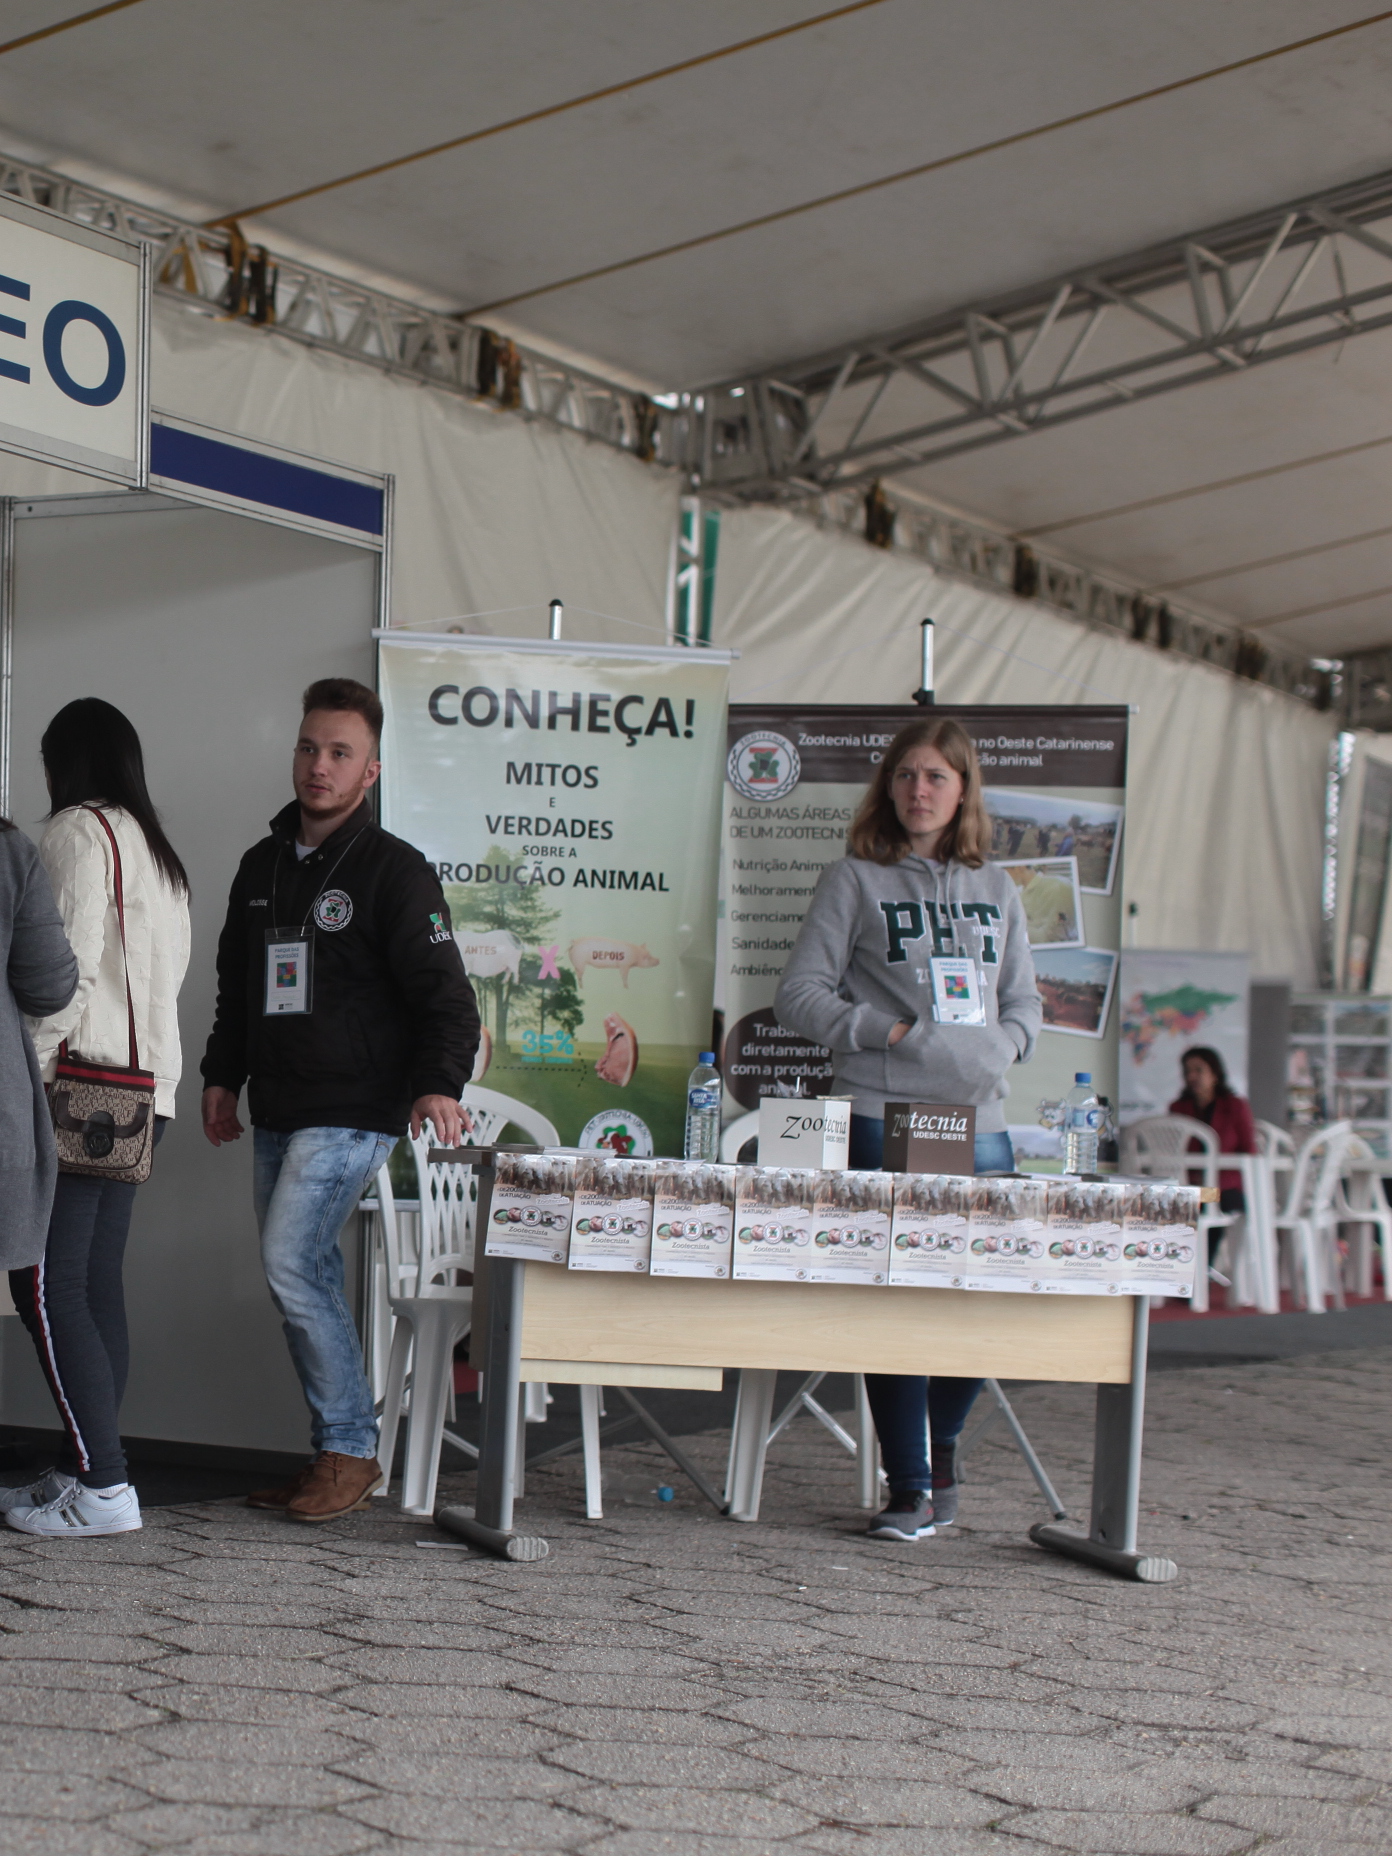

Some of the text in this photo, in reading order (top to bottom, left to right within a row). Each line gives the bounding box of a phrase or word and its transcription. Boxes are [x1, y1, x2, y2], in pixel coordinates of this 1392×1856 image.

[428, 684, 696, 747] CONHEÇA!
[798, 733, 860, 747] Zootecnia
[978, 738, 996, 748] no
[997, 736, 1034, 749] Oeste
[1036, 736, 1115, 750] Catarinense
[999, 753, 1044, 767] animal
[505, 761, 599, 789] MITOS
[549, 797, 556, 808] E
[729, 804, 851, 821] ALGUMAS ÁREAS
[485, 815, 614, 840] VERDADES
[730, 826, 748, 839] DE
[750, 826, 773, 839] UM
[522, 844, 577, 858] SOBRE A
[732, 858, 788, 874] Nutrição
[573, 868, 670, 892] ANIMAL
[731, 936, 796, 950] Sanidade
[464, 945, 497, 955] ANTES
[592, 950, 625, 961] DEPOIS
[521, 1029, 574, 1055] 35%
[741, 1042, 830, 1057] diretamente
[730, 1063, 761, 1075] com
[762, 1064, 772, 1075] a
[913, 1131, 967, 1142] UDESC OESTE
[509, 1226, 548, 1236] Zootecnista
[591, 1236, 630, 1244] Zootecnista
